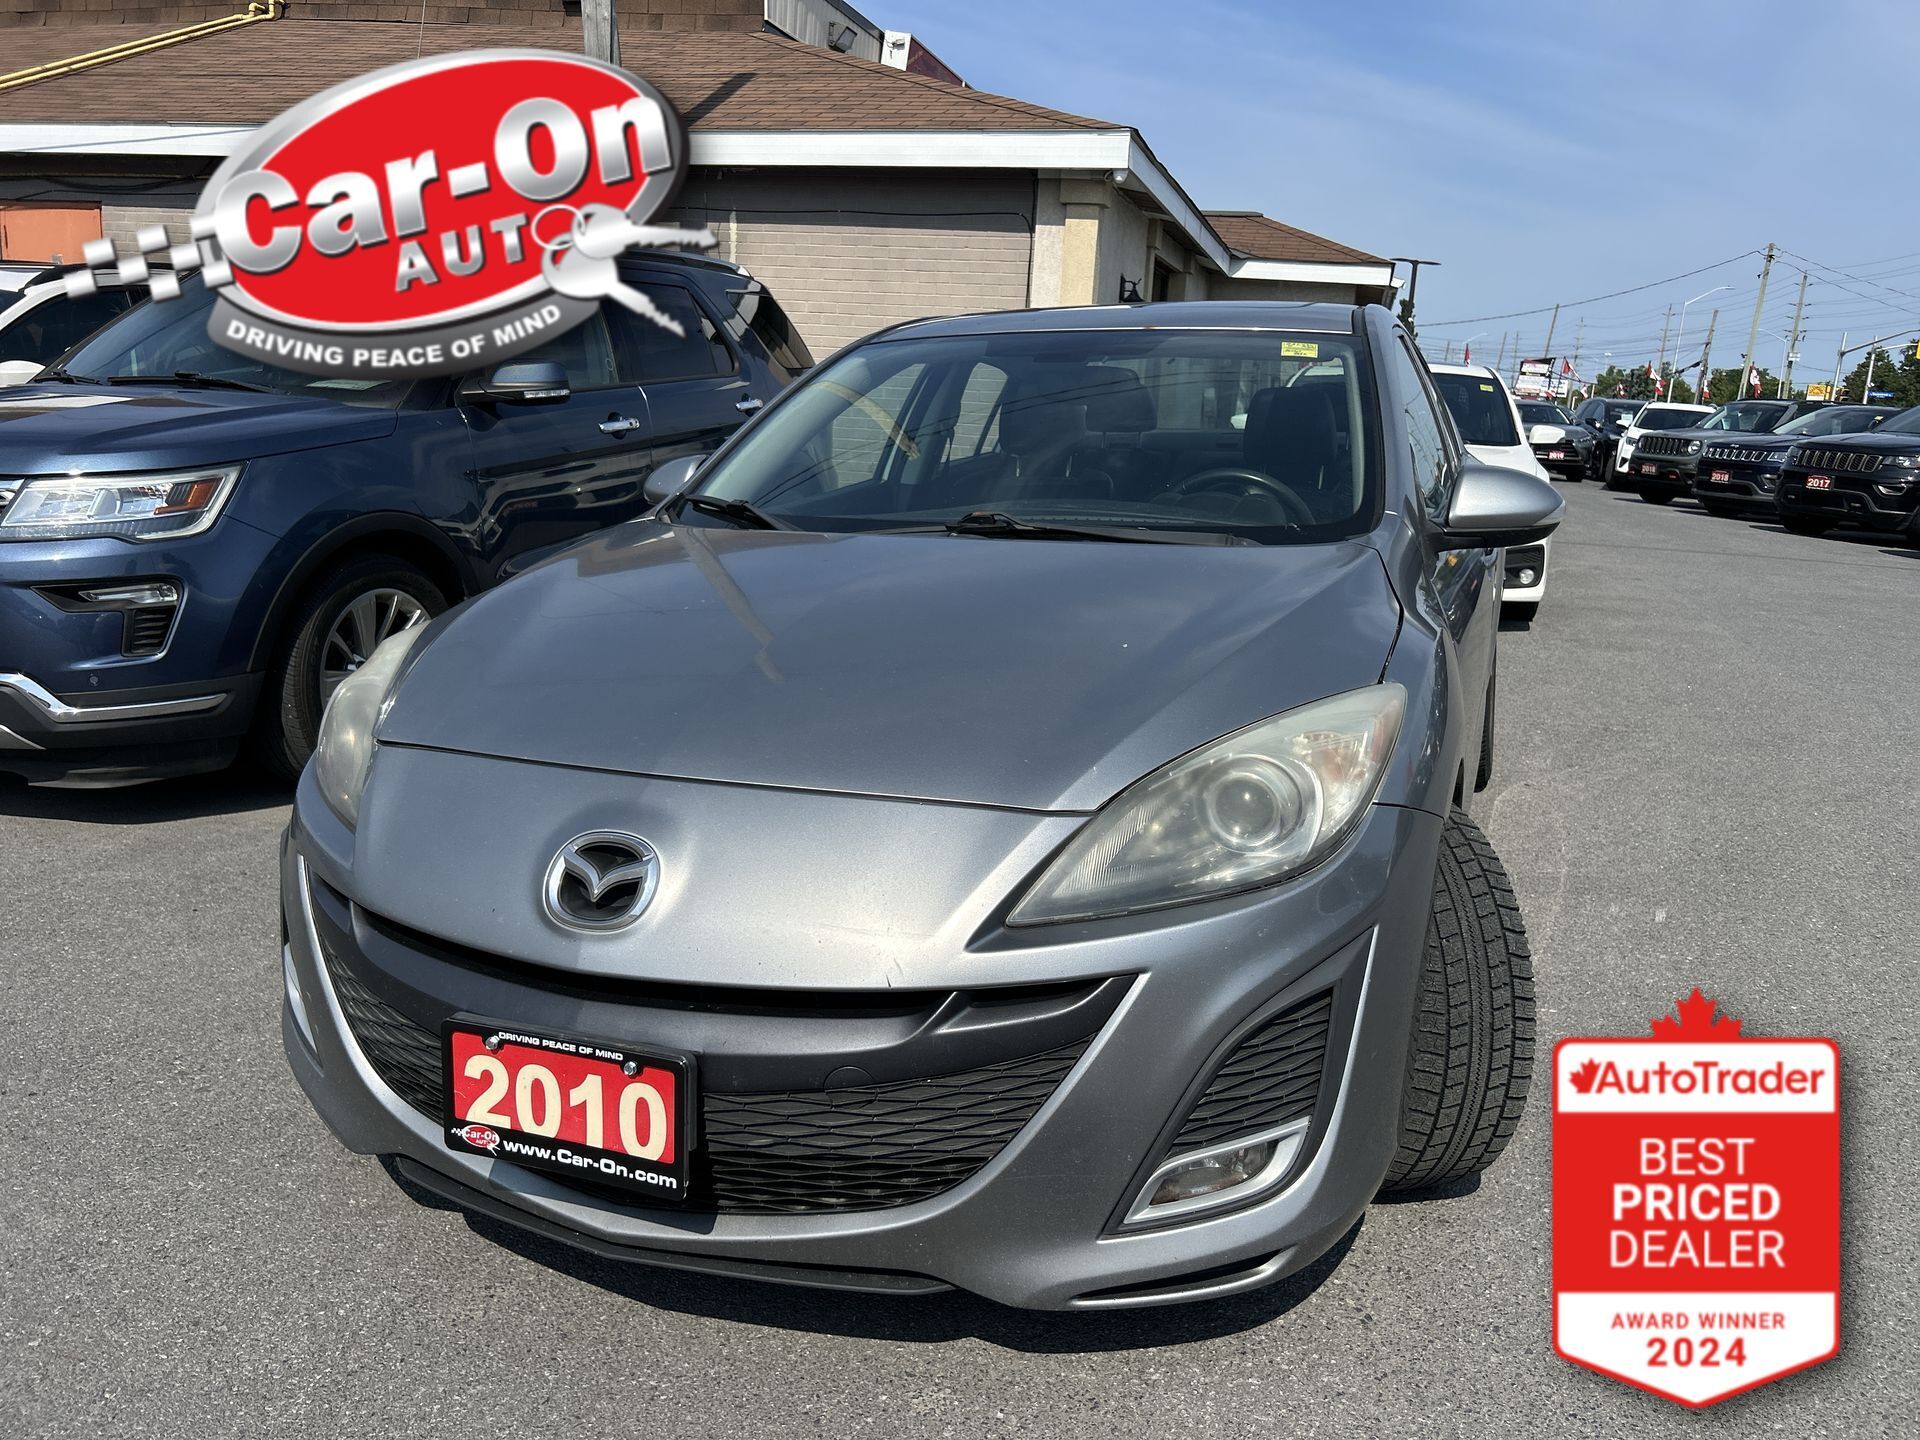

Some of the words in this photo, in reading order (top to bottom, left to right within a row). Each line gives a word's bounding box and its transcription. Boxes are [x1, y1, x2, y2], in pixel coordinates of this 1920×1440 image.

[1711, 473, 1729, 481] 2018
[1807, 478, 1830, 487] 2017
[498, 1031, 540, 1046] DRIVING
[542, 1039, 576, 1052] PEACE
[578, 1046, 594, 1055] OF
[595, 1048, 624, 1061] MIND
[464, 1054, 667, 1161] 2010
[463, 1128, 498, 1142] Car-On
[503, 1139, 677, 1190] www.Car-On.com
